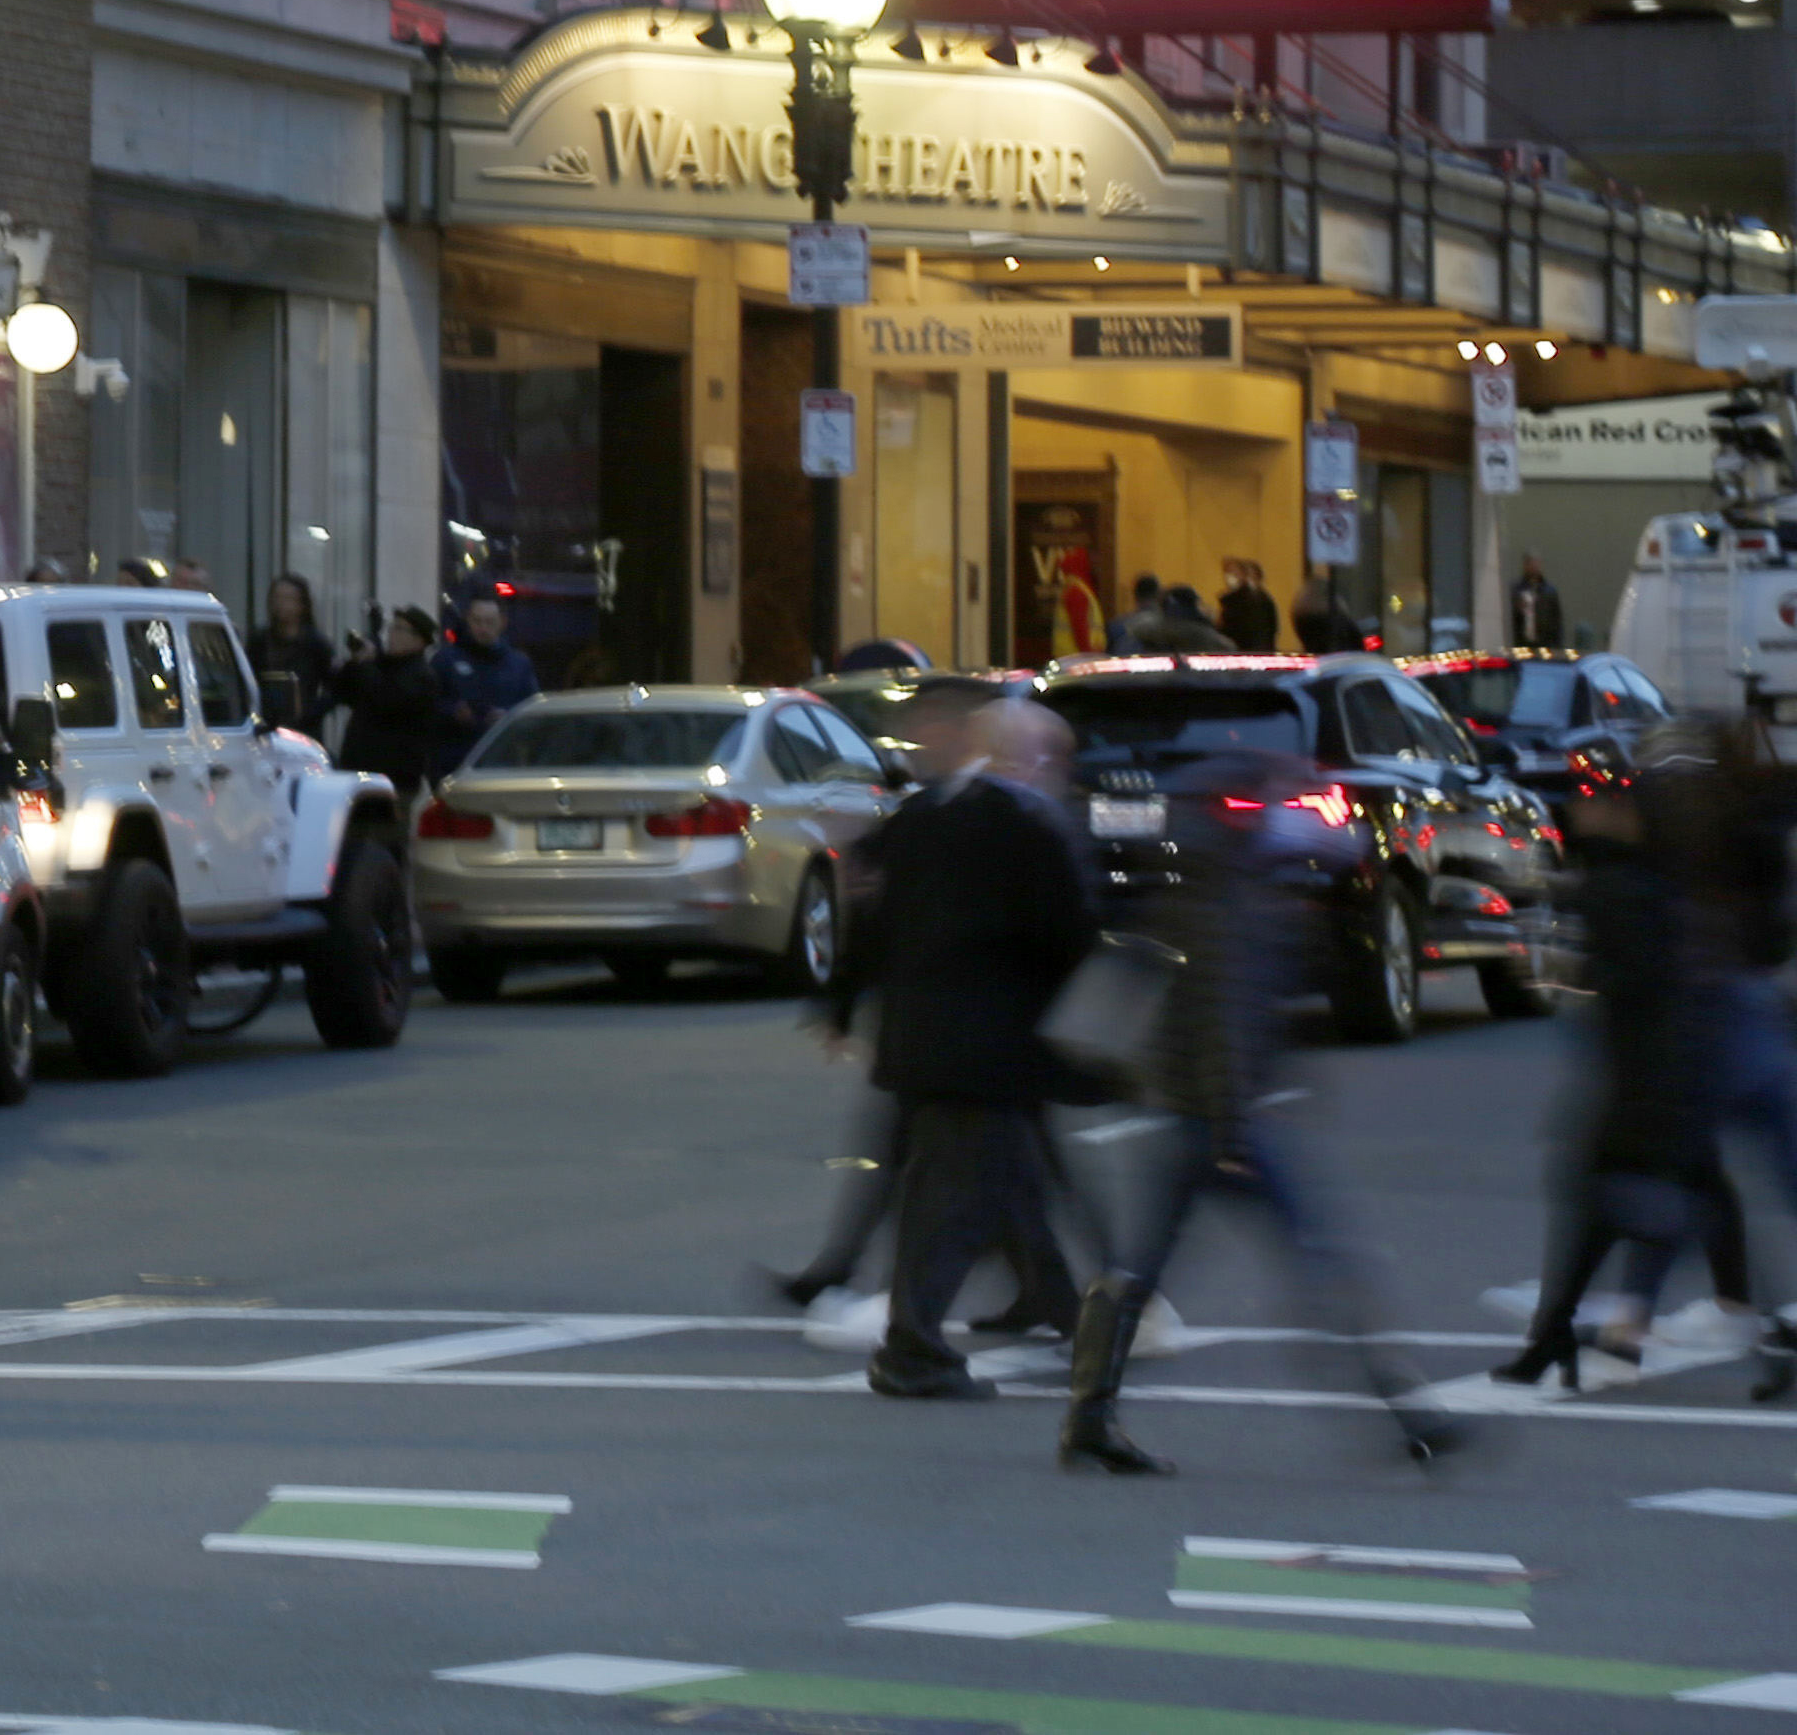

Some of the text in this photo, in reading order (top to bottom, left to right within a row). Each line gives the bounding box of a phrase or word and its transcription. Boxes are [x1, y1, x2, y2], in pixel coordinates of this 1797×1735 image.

[597, 102, 1090, 212] WANG HEATRE
[862, 315, 973, 356] Tufts
[977, 314, 1064, 338] Medical
[976, 336, 1046, 356] Center
[1517, 418, 1710, 444] ican Red Cro
